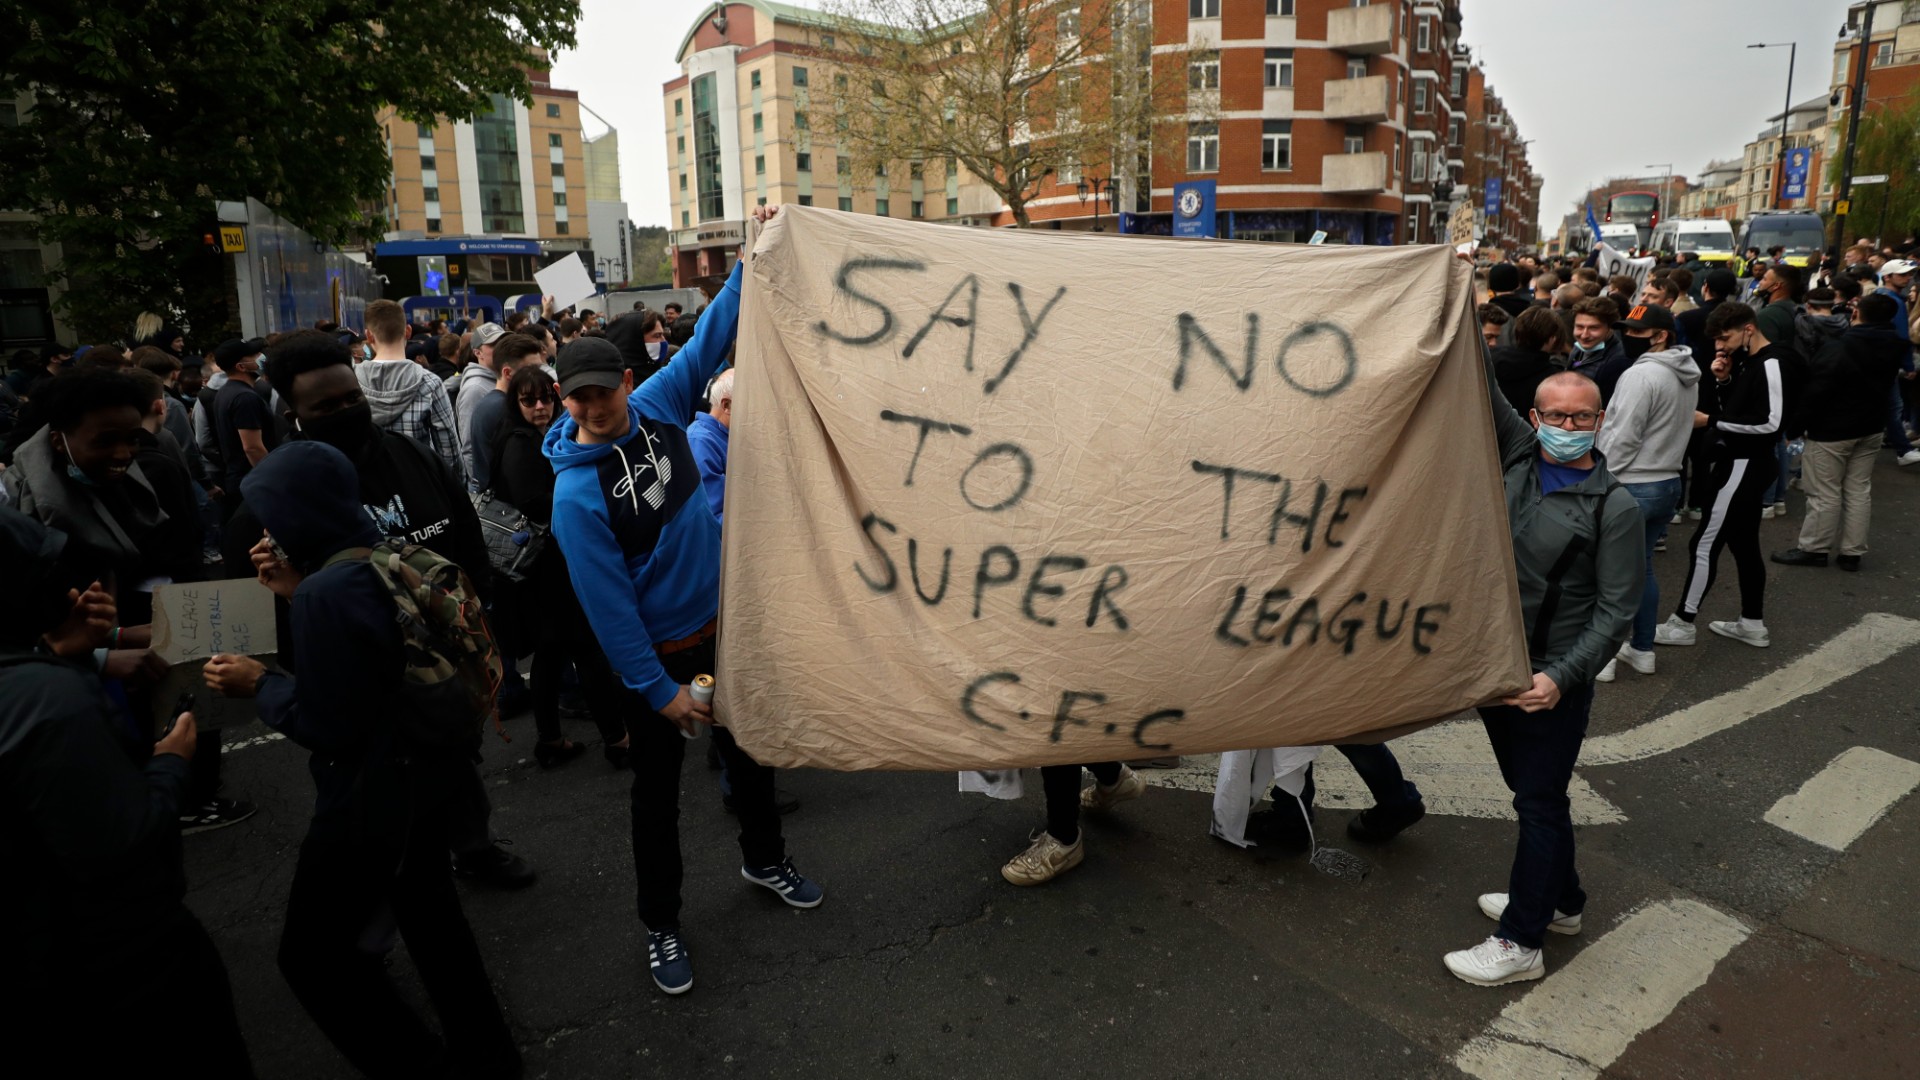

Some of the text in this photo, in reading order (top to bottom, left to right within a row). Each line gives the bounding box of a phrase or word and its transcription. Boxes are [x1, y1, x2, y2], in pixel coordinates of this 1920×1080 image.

[223, 233, 242, 247] TAXI
[811, 257, 1359, 398] SAY NO
[880, 408, 1367, 554] TO THE
[181, 588, 199, 640] LEAGUE
[208, 588, 224, 654] FOOTBALL
[852, 511, 1452, 656] SUPER LEAGUE
